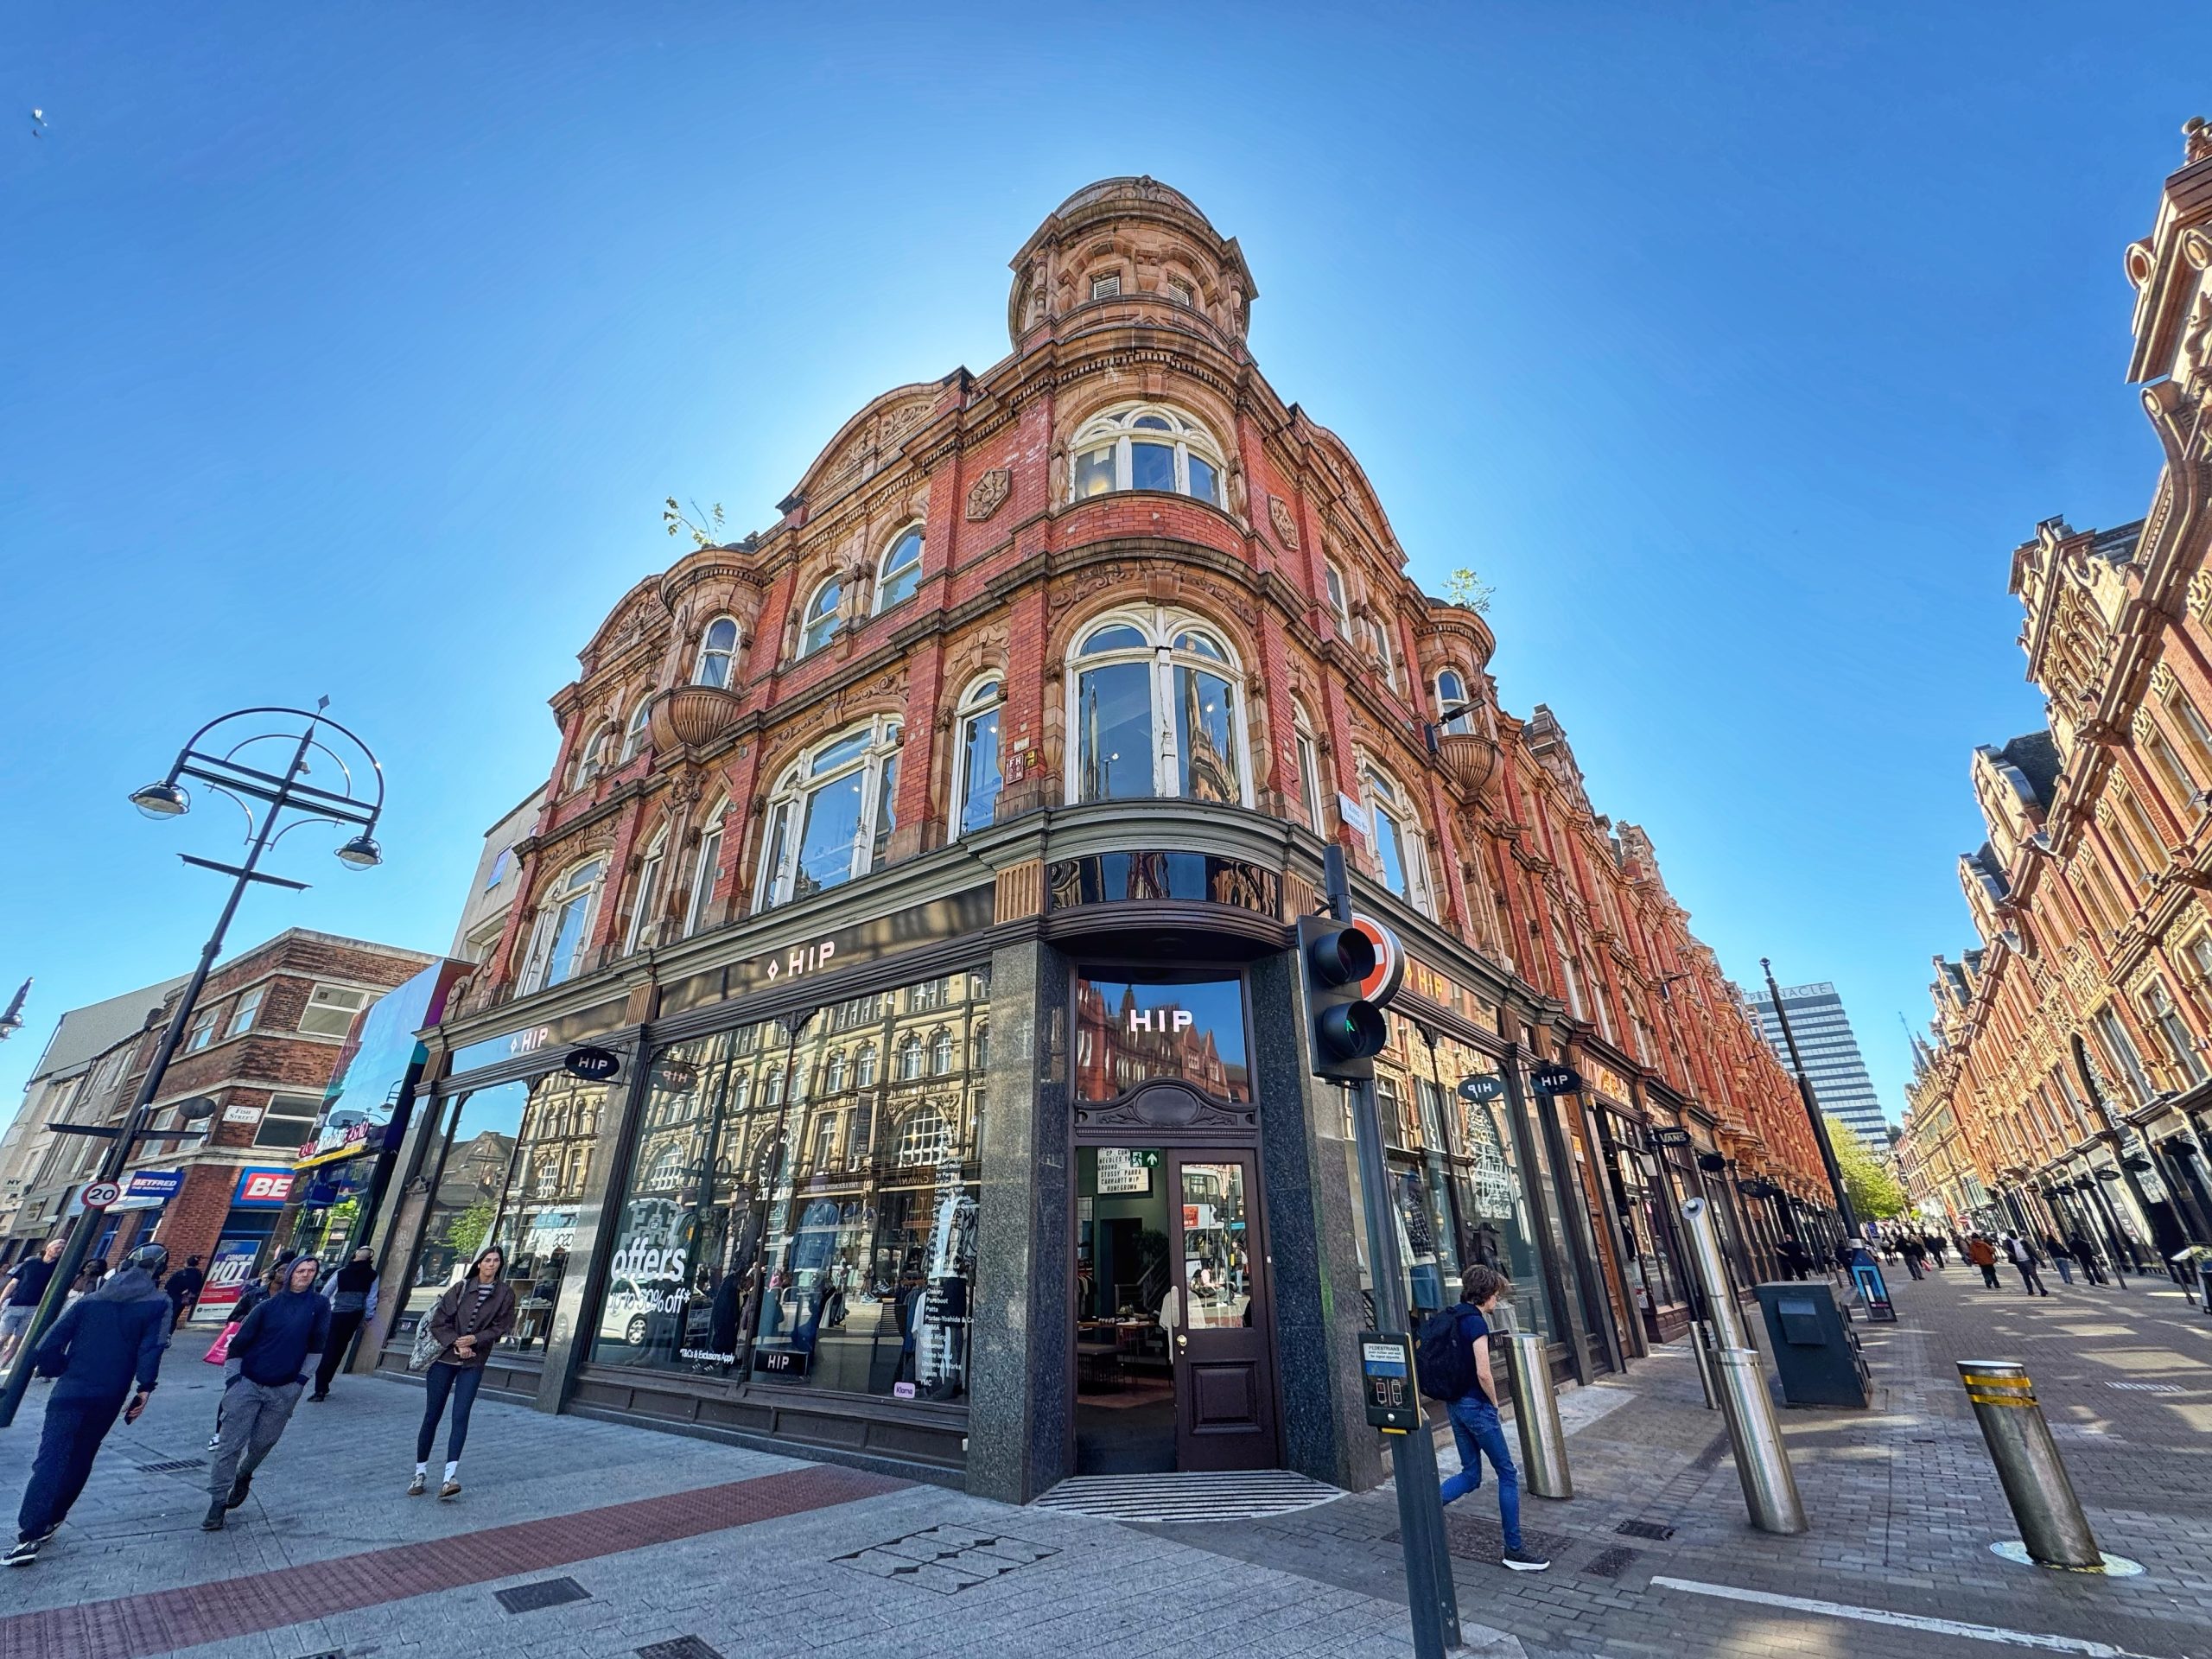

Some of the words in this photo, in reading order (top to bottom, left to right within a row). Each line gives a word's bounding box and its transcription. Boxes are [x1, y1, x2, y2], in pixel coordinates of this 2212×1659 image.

[788, 941, 836, 977] HIP
[1418, 967, 1443, 999] HIP
[1130, 1009, 1192, 1033] HIP
[521, 1027, 549, 1053] HIP
[578, 1057, 608, 1071] HIP
[1541, 1074, 1568, 1087] HIP
[1659, 1132, 1687, 1143] VANS
[132, 1179, 178, 1187] BETFRED
[89, 1188, 115, 1200] 20
[207, 1261, 252, 1282] HOT
[721, 1351, 734, 1365] Apply
[767, 1355, 789, 1370] HIP
[896, 1386, 913, 1395] Klarna
